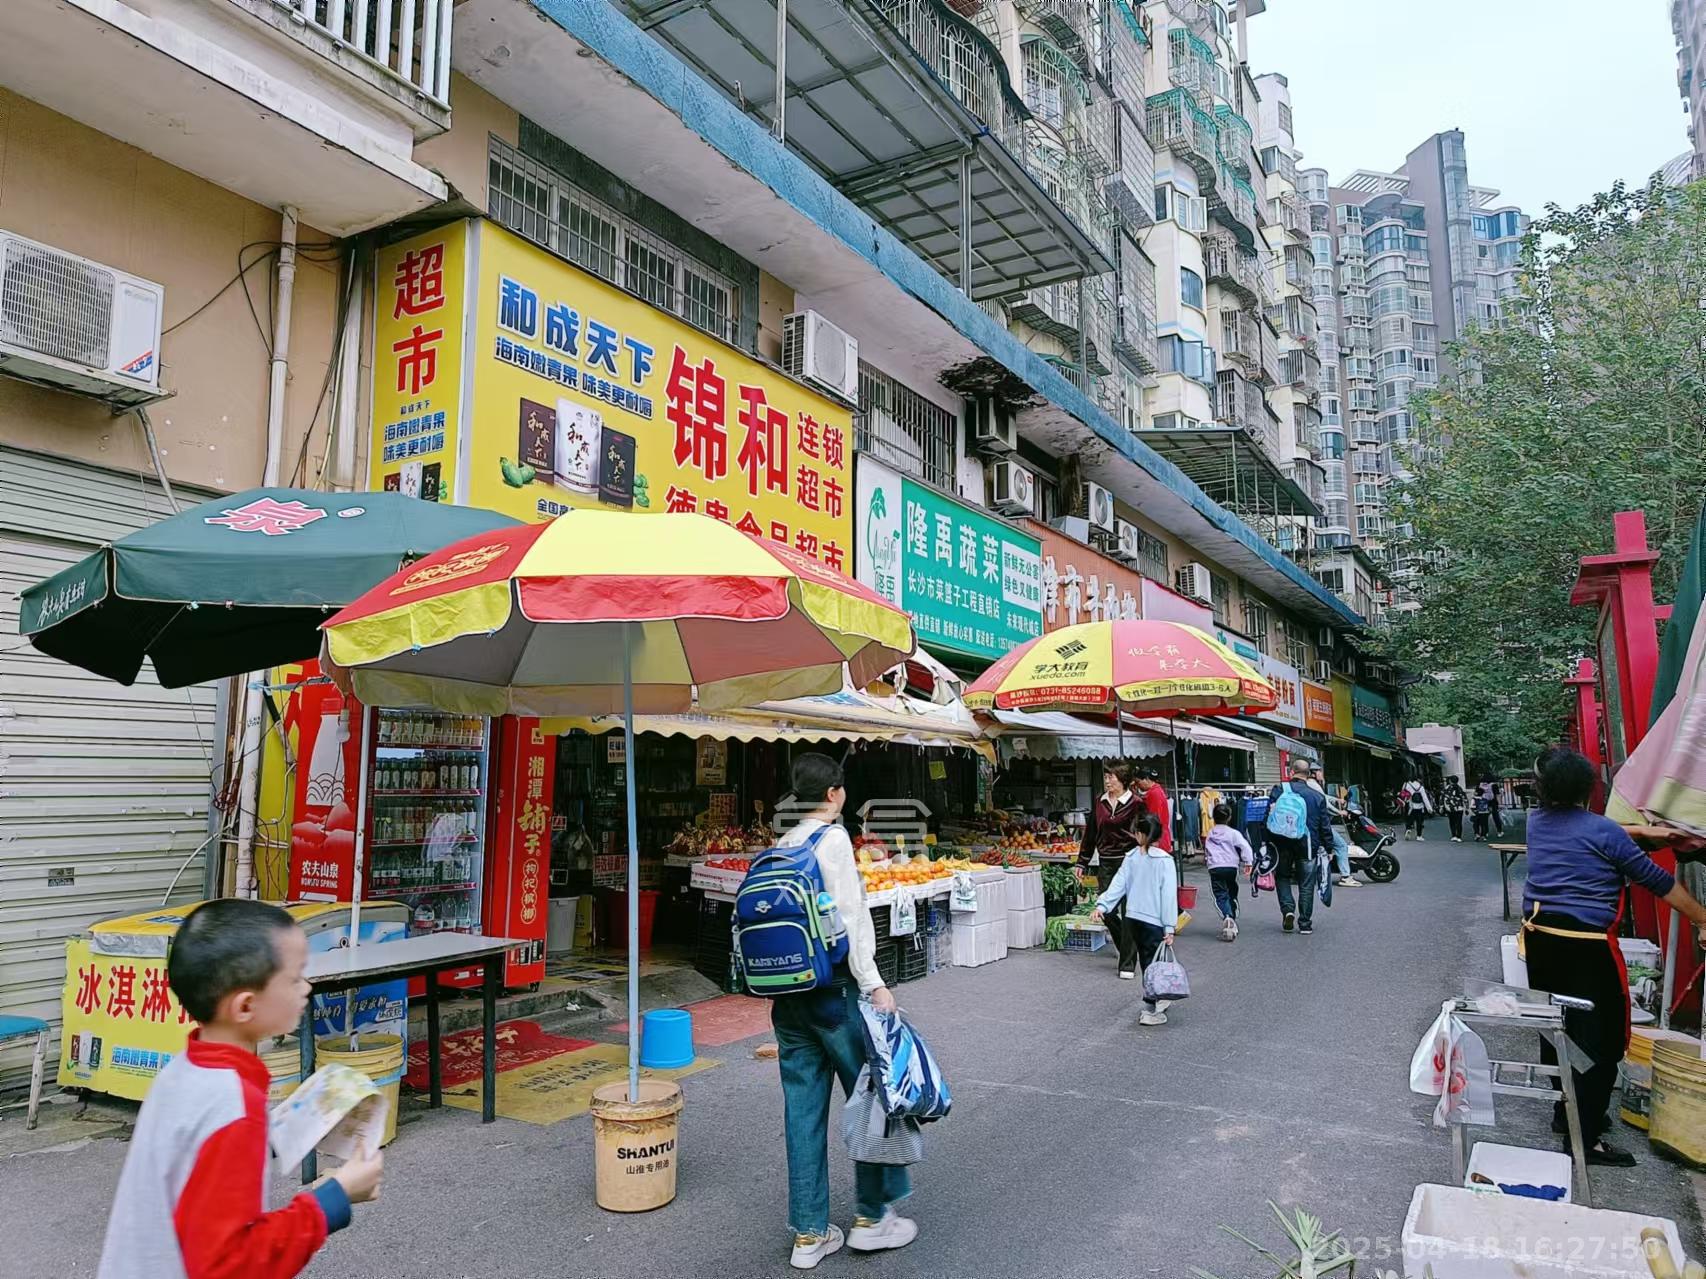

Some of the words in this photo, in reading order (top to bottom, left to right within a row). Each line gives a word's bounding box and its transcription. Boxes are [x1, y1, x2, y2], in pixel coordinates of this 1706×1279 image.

[393, 244, 445, 395] 超市
[500, 278, 654, 384] 和成天下
[496, 336, 578, 388] 海南嫩青果
[664, 345, 790, 496] 锦和
[796, 412, 844, 471] 连锁
[537, 498, 575, 516] 全国
[796, 465, 844, 519] 超市
[906, 499, 1000, 584] 隆禹蔬菜
[1034, 661, 1089, 674] 学大教育
[517, 756, 550, 855] 湘潭铺子
[302, 860, 339, 879] 农夫山泉
[75, 963, 196, 1024] 冰淇淋
